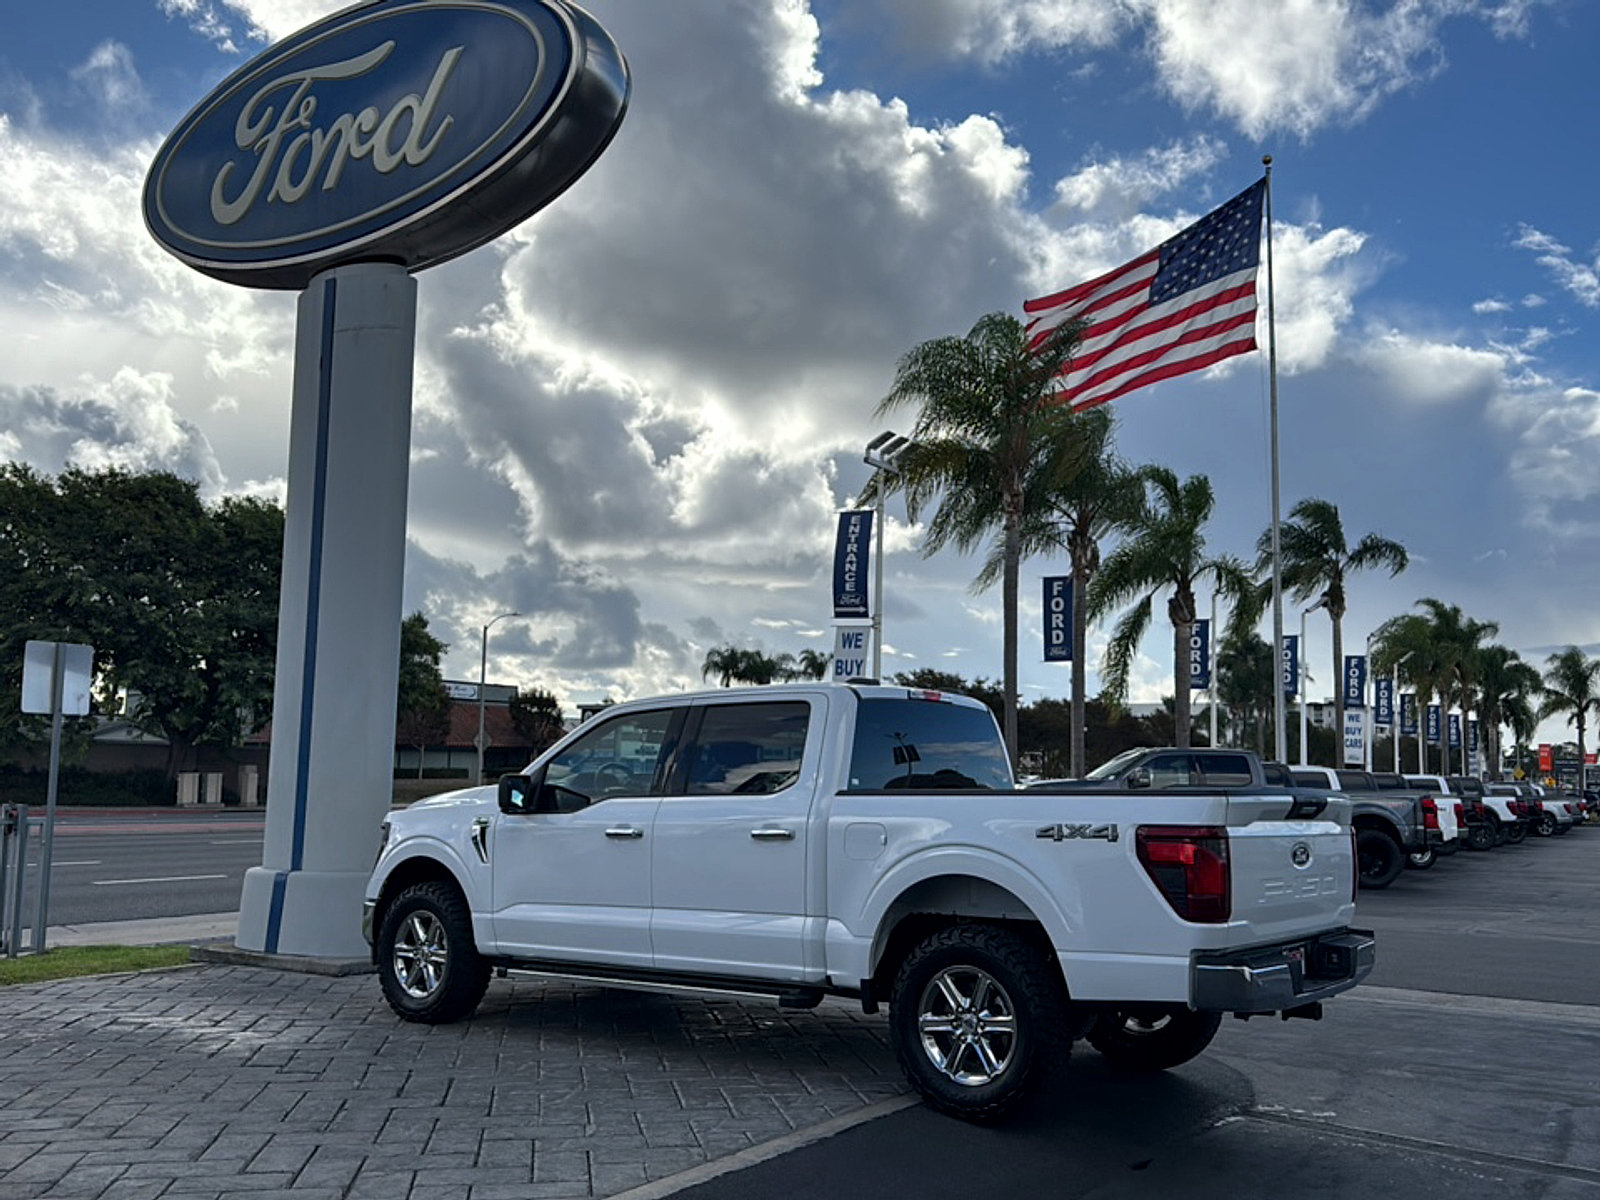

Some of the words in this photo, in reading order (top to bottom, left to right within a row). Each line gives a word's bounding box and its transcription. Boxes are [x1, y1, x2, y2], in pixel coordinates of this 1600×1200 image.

[210, 39, 465, 226] Ford
[845, 515, 861, 591] ENTRANCE
[1051, 581, 1065, 645] FORD
[841, 633, 863, 649] WE
[1190, 623, 1202, 675] FORD
[835, 659, 864, 676] BUY
[1282, 639, 1292, 683] FORD
[1349, 658, 1360, 698] FORD
[1379, 681, 1389, 716] FORD
[1345, 727, 1362, 736] BUY
[1347, 714, 1361, 723] WE
[1429, 706, 1437, 735] FORD
[1345, 739, 1362, 748] CARS
[1035, 823, 1119, 842] 4X4
